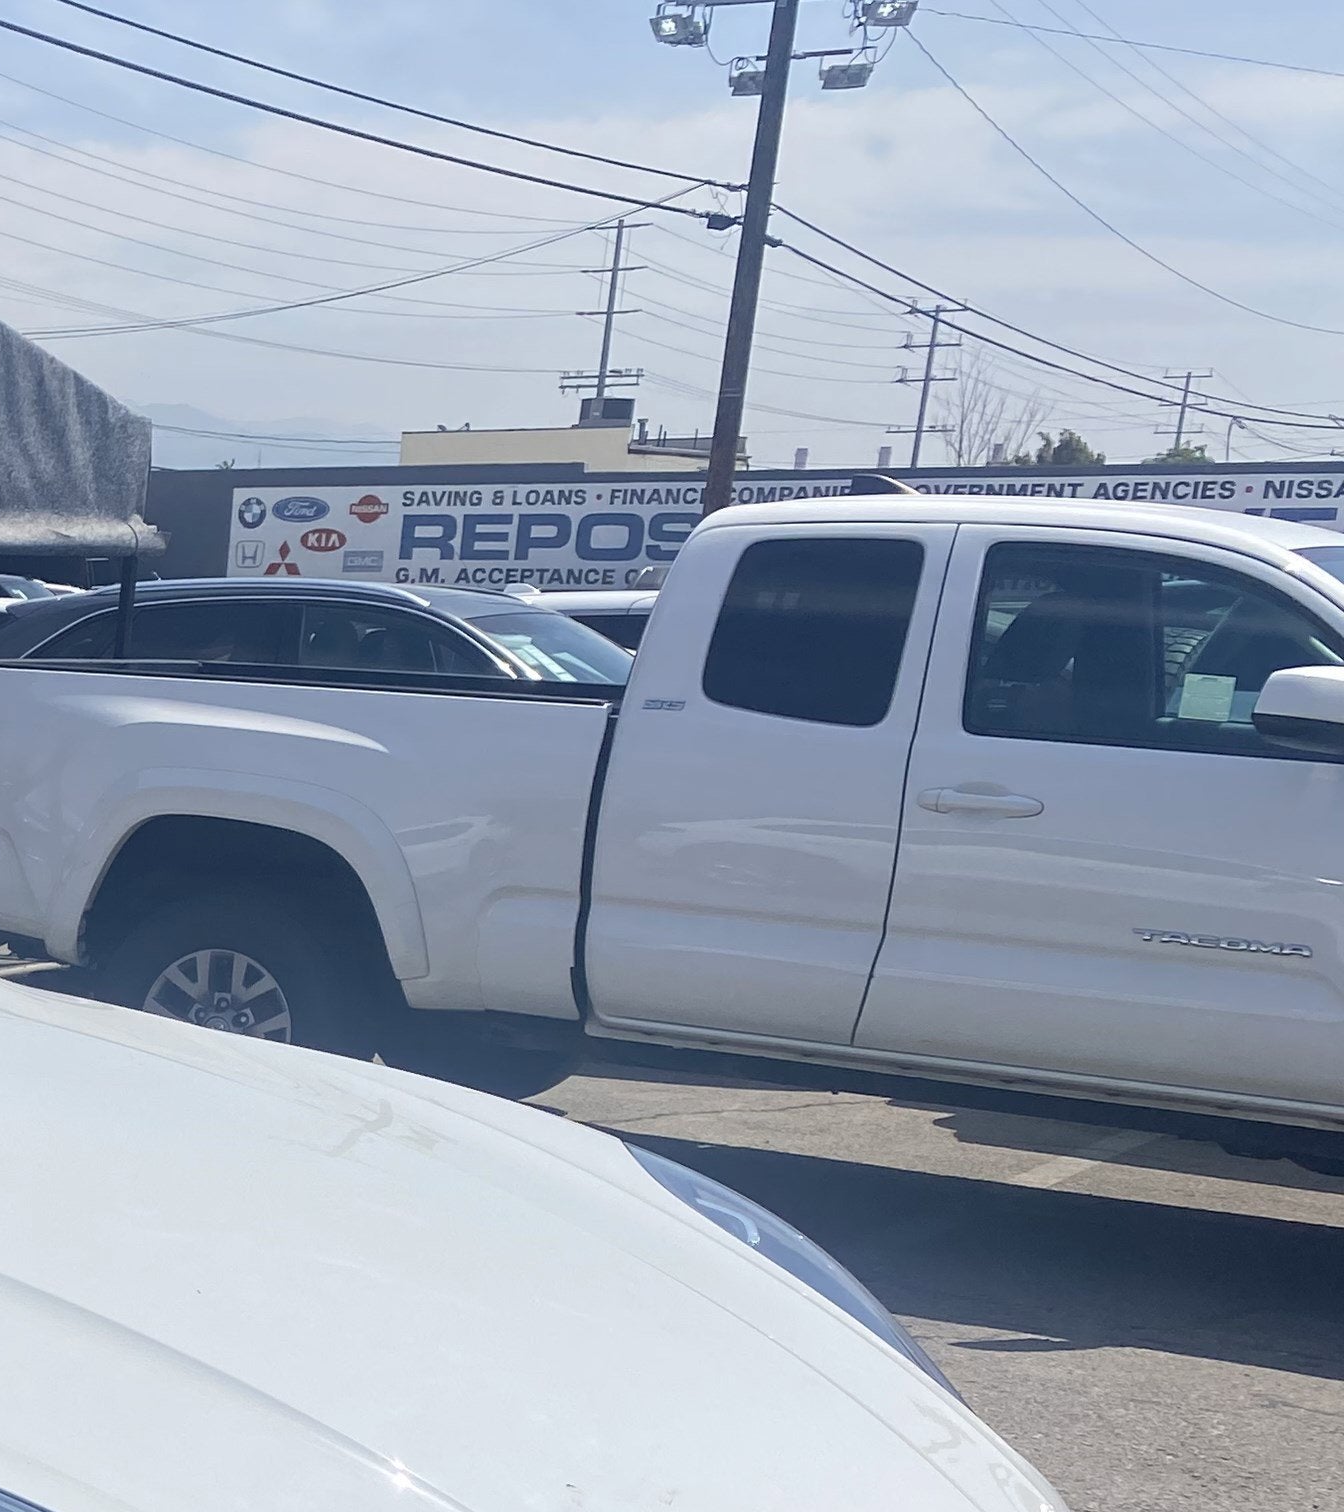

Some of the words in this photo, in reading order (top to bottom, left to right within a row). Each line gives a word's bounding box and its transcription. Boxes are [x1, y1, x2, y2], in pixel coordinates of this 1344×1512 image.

[402, 490, 483, 507] SAVING
[492, 490, 504, 507] &
[511, 489, 587, 506] LOANS
[609, 487, 705, 505] FINANC
[1092, 480, 1237, 500] AGENCIES
[283, 501, 318, 517] Ford
[350, 504, 389, 513] NISSAN
[307, 533, 340, 547] KIA
[398, 513, 704, 562] REPOS
[346, 556, 379, 566] GMC
[395, 566, 446, 584] G.M.
[454, 567, 616, 585] ACCEPTANCE
[1132, 927, 1312, 957] TACOMA
